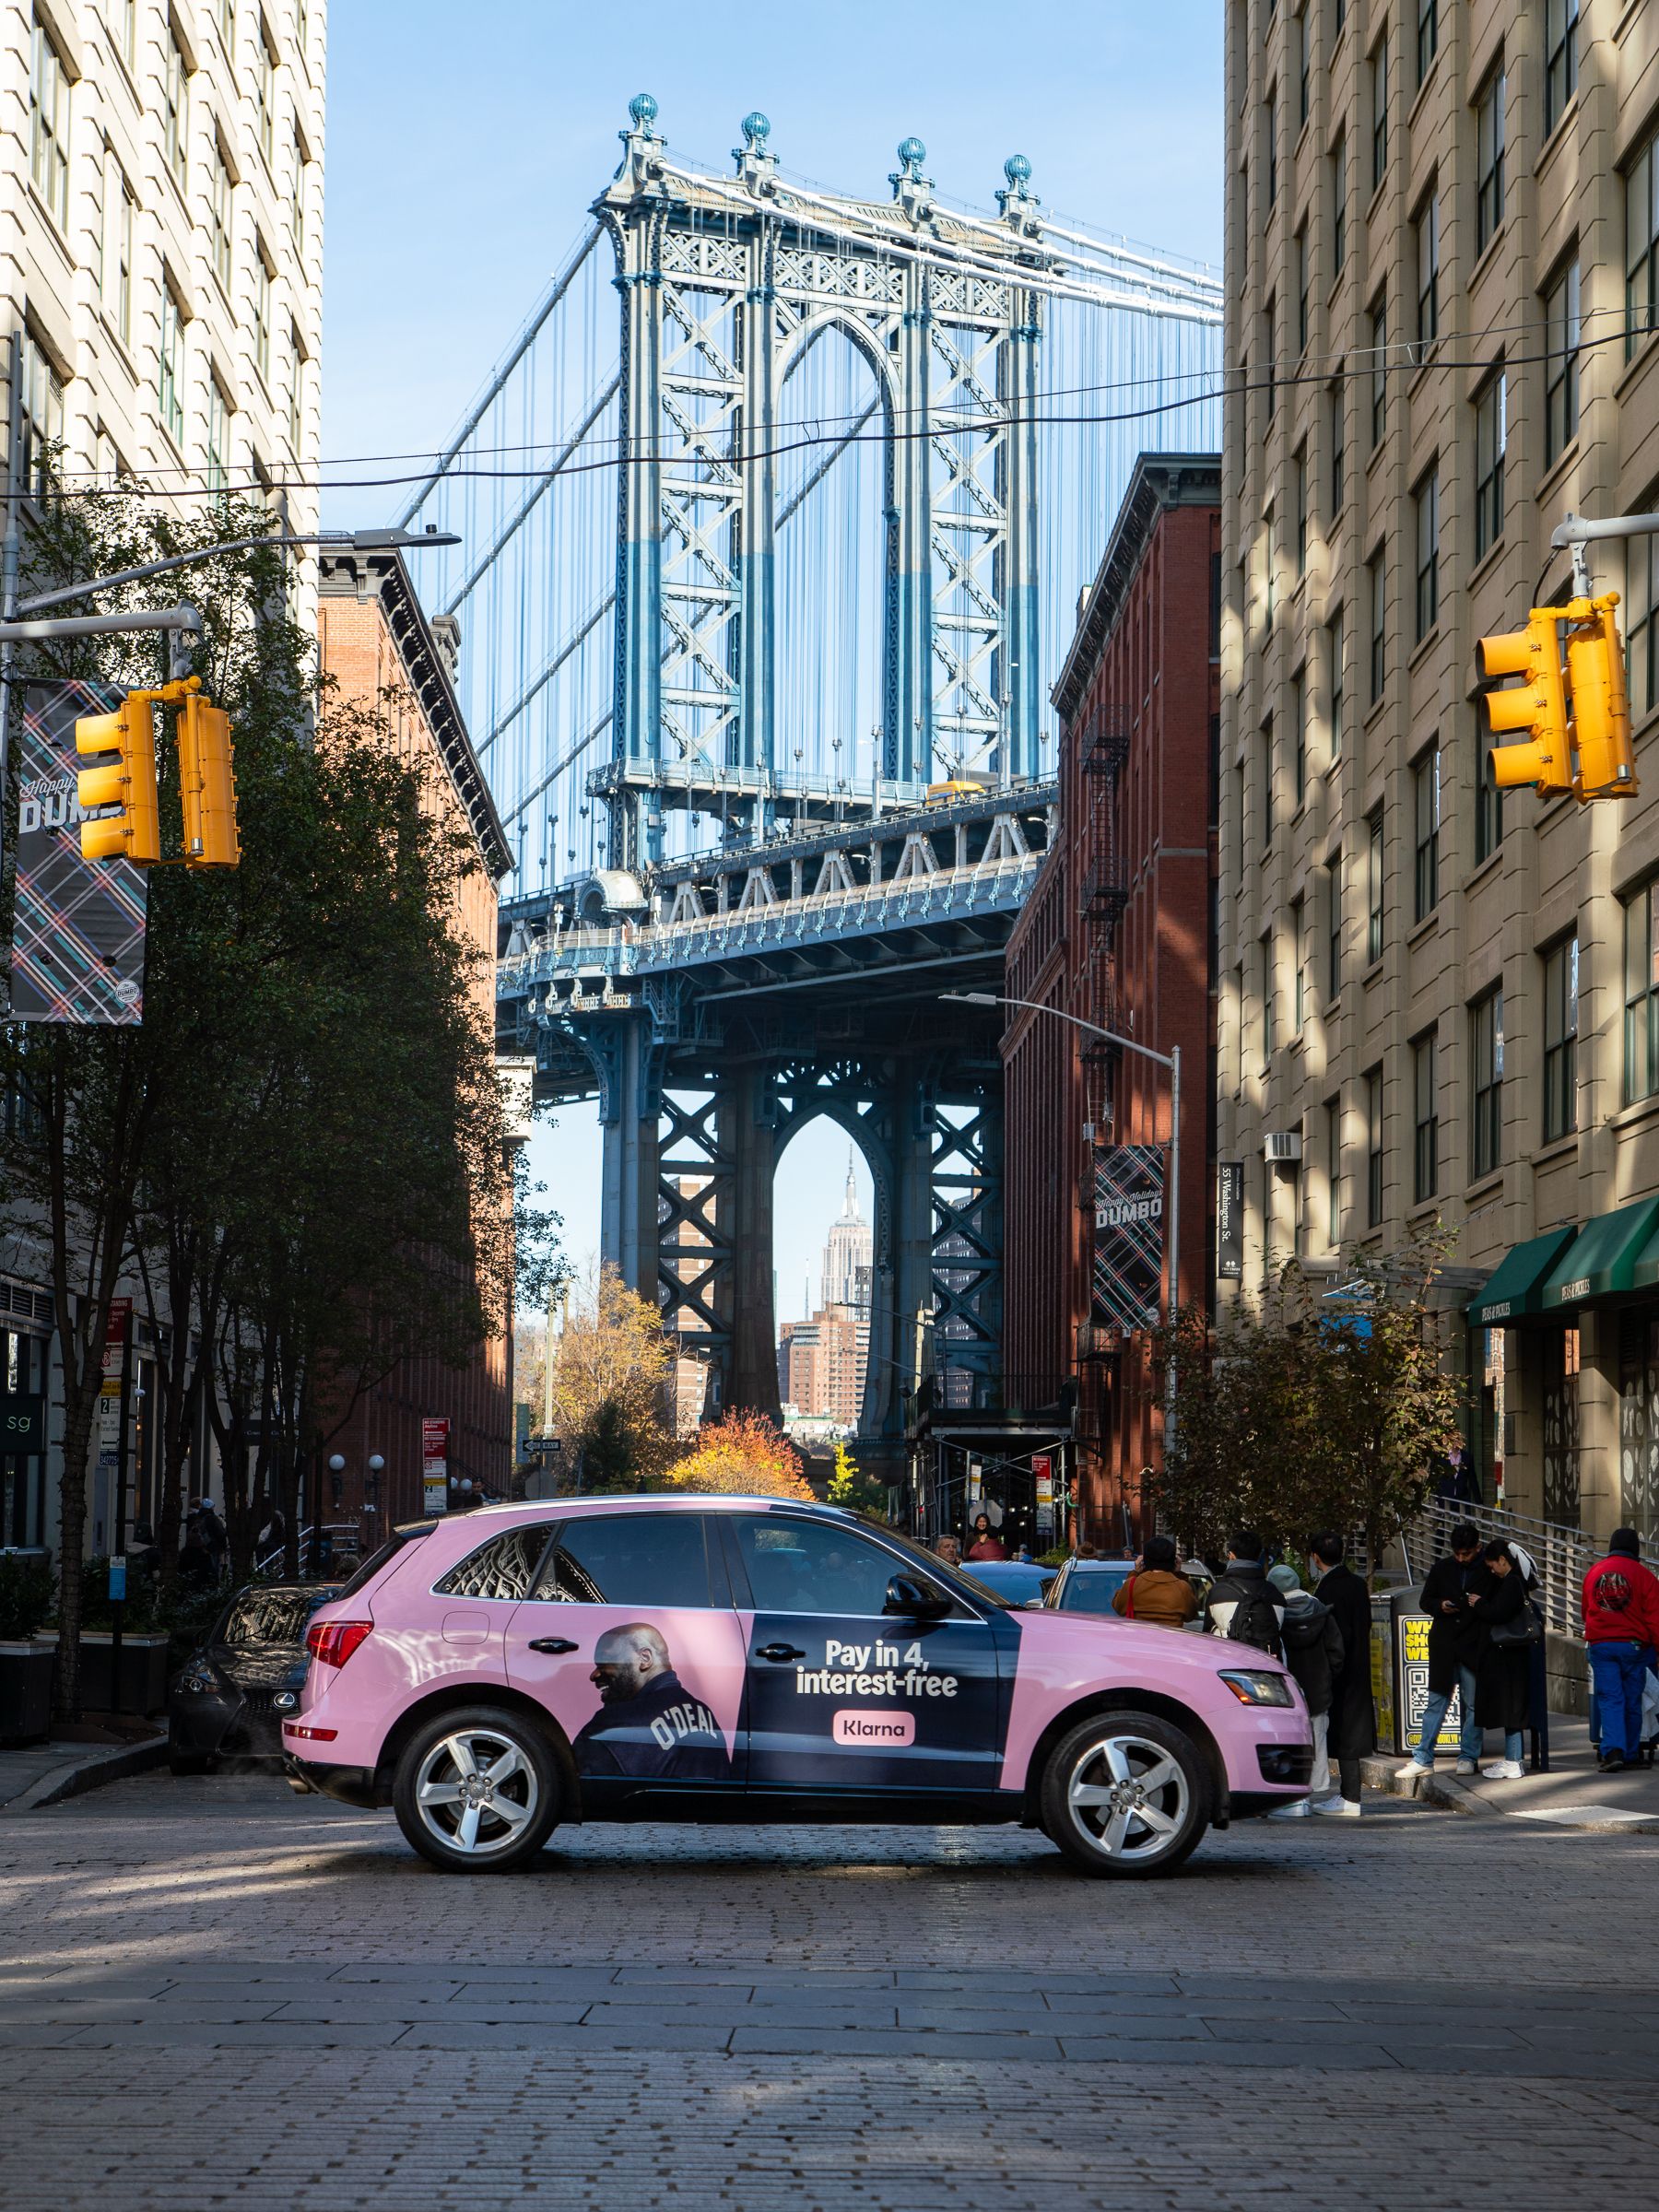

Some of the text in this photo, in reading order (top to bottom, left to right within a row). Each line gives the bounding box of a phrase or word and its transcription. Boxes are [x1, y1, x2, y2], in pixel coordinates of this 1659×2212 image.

[19, 776, 76, 798] Happy
[117, 987, 137, 996] DUMBO
[1095, 1188, 1163, 1210] Happy Holidays
[1219, 1167, 1231, 1242] 55 Washington St.
[1096, 1198, 1162, 1229] DUMBO
[1561, 1284, 1571, 1301] PEAS
[1575, 1278, 1591, 1297] PICKLES
[1481, 1305, 1492, 1322] PEAS
[1495, 1301, 1511, 1319] PICKLES
[102, 1398, 108, 1413] 2
[6, 1416, 31, 1433] sg
[528, 1441, 540, 1450] ONE
[1405, 1620, 1433, 1635] WH
[825, 1639, 930, 1673] Pay in 4,
[796, 1665, 959, 1698] interest-free
[650, 1702, 717, 1751] O'DEAL
[842, 1719, 906, 1737] Klarna
